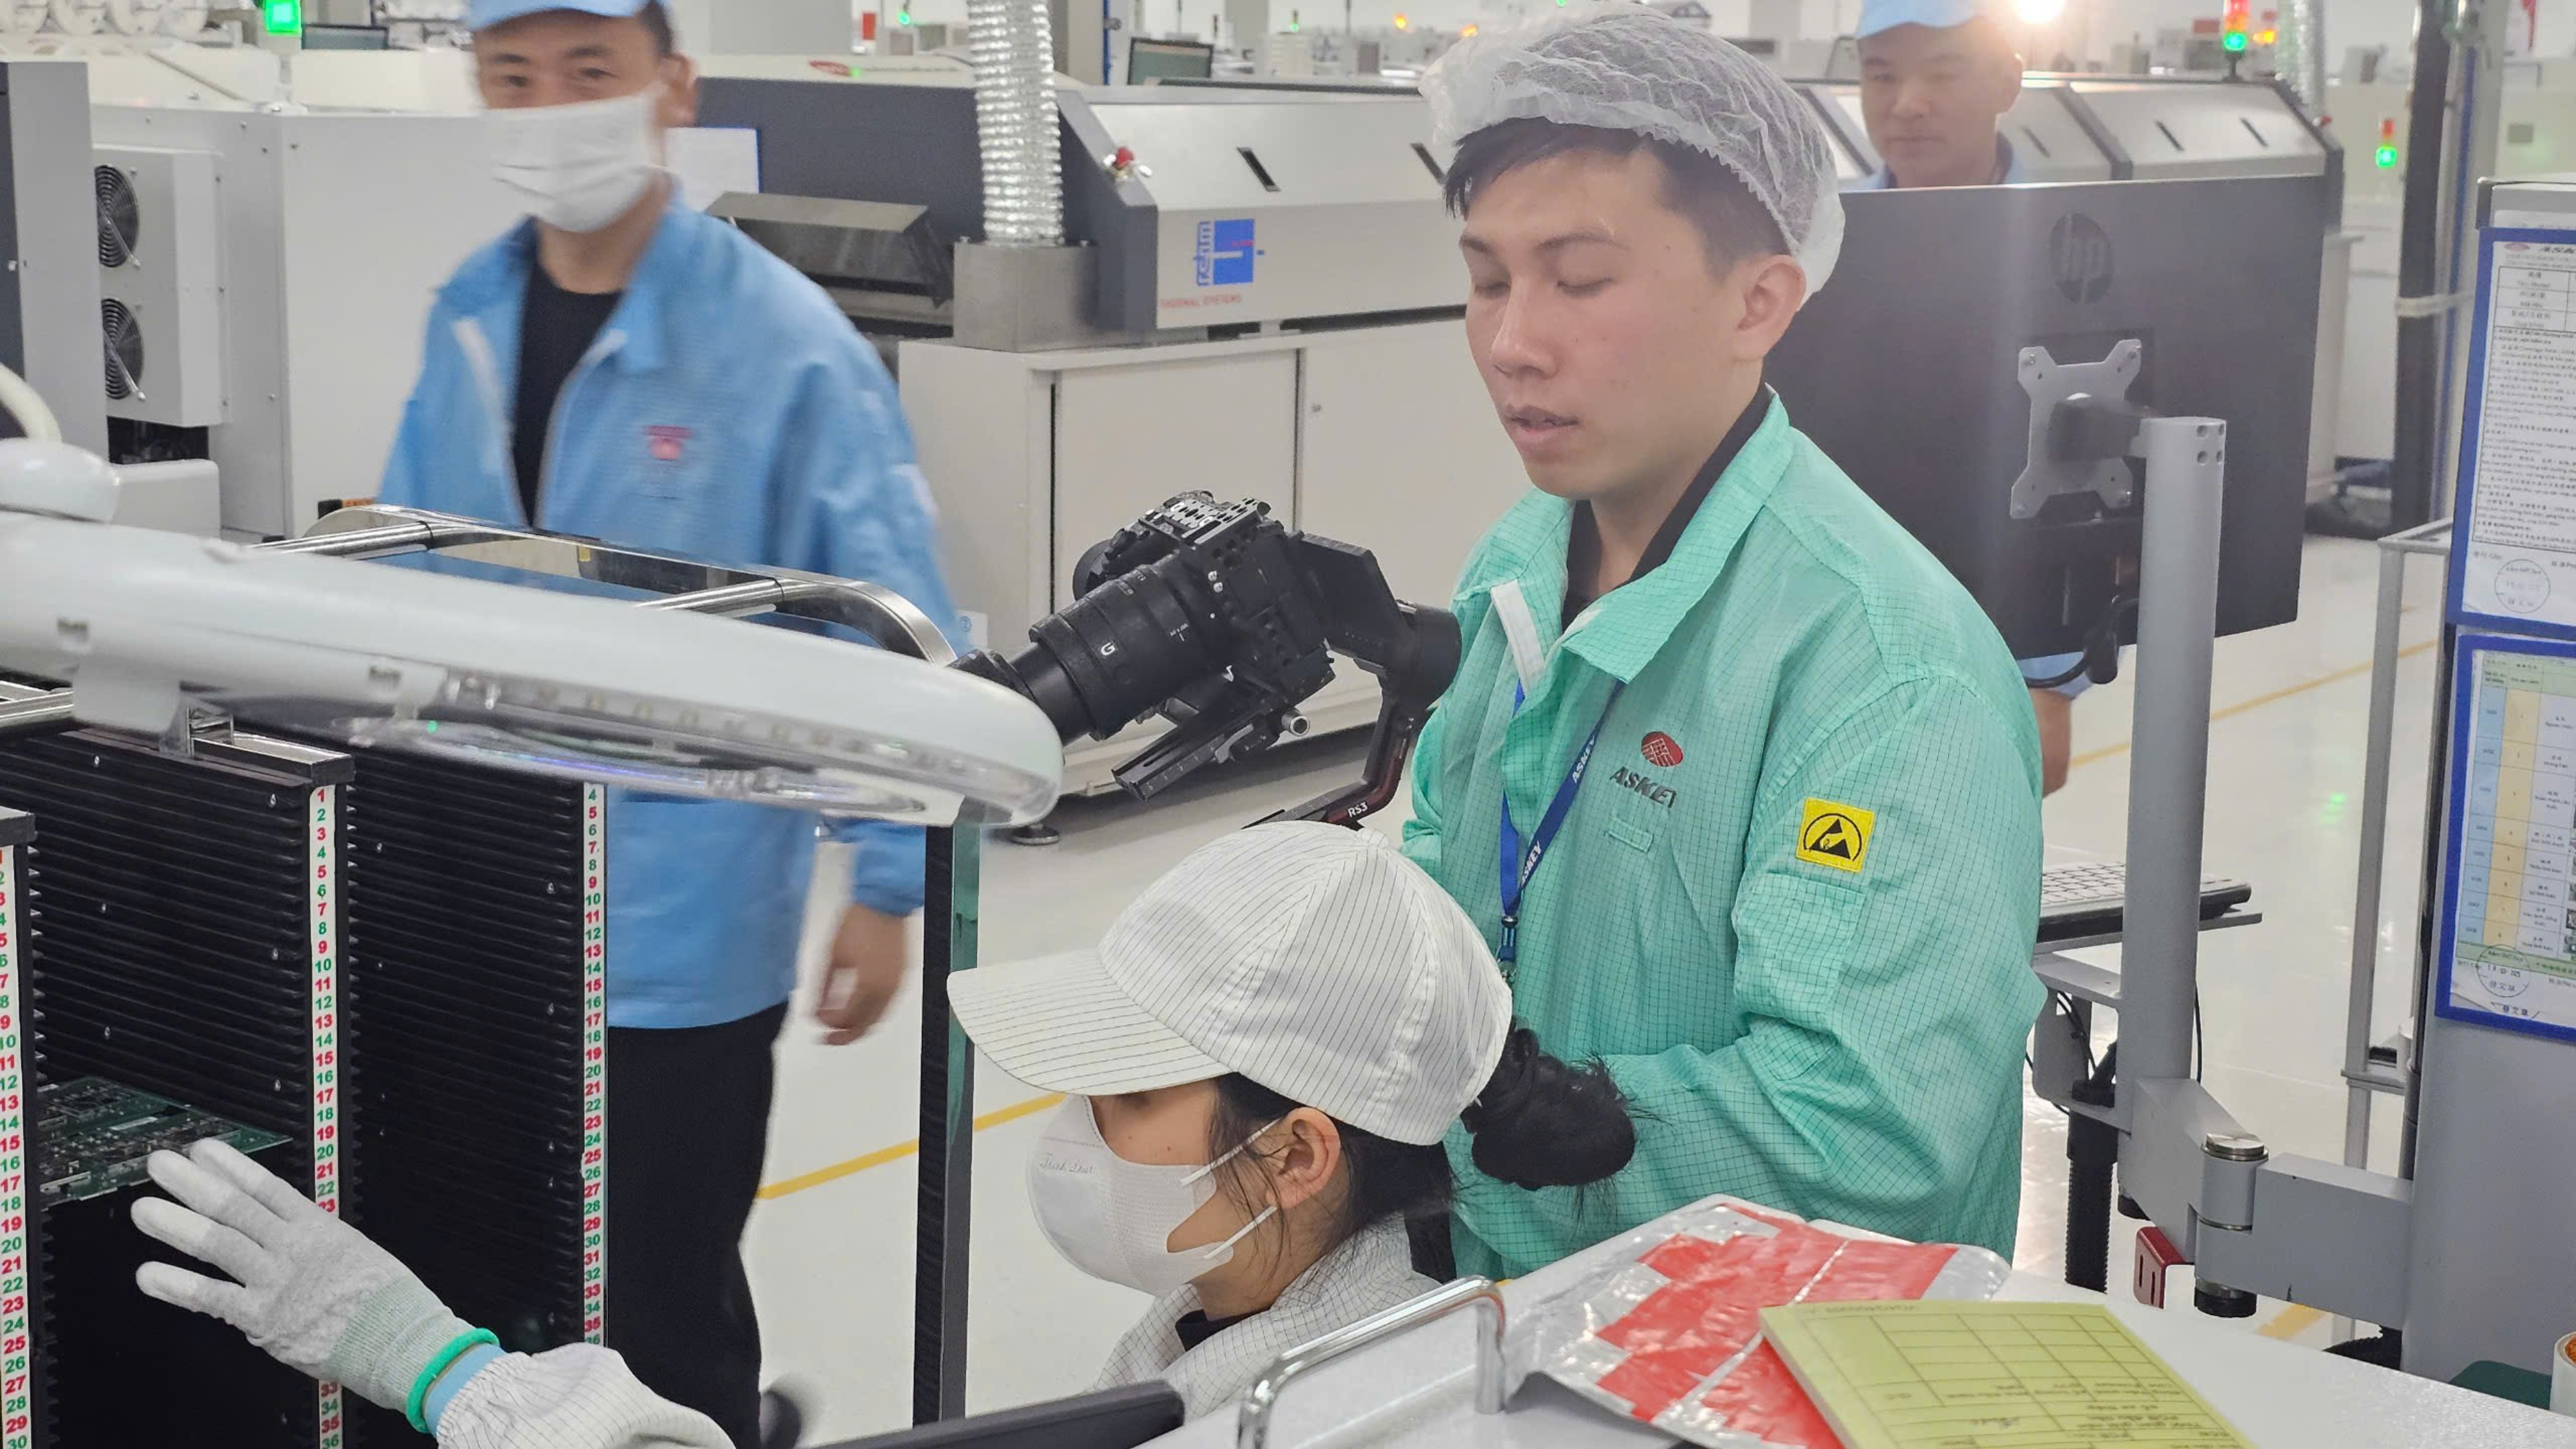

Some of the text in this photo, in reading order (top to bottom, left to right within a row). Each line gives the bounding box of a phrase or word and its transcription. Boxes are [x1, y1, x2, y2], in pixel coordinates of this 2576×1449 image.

[1100, 642, 1116, 655] G
[317, 789, 325, 802] 1
[588, 789, 596, 800] 4
[317, 809, 326, 821] 2
[589, 807, 597, 818] 5
[1348, 802, 1368, 818] RS3
[317, 827, 326, 840] 3
[589, 824, 596, 835] 6
[317, 846, 326, 859] 4
[588, 841, 596, 853] 7
[317, 864, 326, 878] 5
[589, 860, 596, 870] 8
[589, 876, 597, 888] 9
[317, 884, 326, 897] 6
[586, 893, 601, 906] 10
[318, 902, 327, 916] 7
[586, 910, 599, 924] 11
[319, 921, 327, 934] 8
[586, 928, 601, 941] 12
[0, 932, 8, 947] 5
[318, 941, 328, 954] 9
[586, 945, 601, 958] 13
[315, 958, 332, 973] 10
[586, 963, 601, 975] 14
[0, 974, 8, 989] 7
[315, 976, 330, 992] 11
[586, 978, 602, 993] 15
[0, 995, 9, 1008] 8
[315, 996, 332, 1010] 12
[586, 996, 601, 1010] 16
[0, 1015, 11, 1030] 9
[315, 1014, 332, 1029] 13
[586, 1013, 602, 1028] 17
[0, 1035, 16, 1050] 10
[316, 1033, 332, 1047] 14
[586, 1031, 601, 1044] 18
[316, 1051, 333, 1066] 15
[585, 1046, 602, 1061] 19
[0, 1055, 15, 1071] 11
[316, 1070, 333, 1085] 16
[585, 1064, 601, 1079] 20
[0, 1075, 17, 1090] 12
[585, 1081, 600, 1096] 21
[0, 1094, 19, 1112] 13
[317, 1088, 333, 1104] 17
[585, 1099, 601, 1112] 22
[317, 1107, 333, 1122] 18
[585, 1114, 602, 1130] 23
[0, 1115, 19, 1132] 14
[317, 1125, 335, 1141] 19
[585, 1132, 601, 1147] 24
[0, 1135, 21, 1152] 15
[317, 1144, 334, 1160] 20
[585, 1148, 601, 1165] 25
[1, 1156, 20, 1172] 16
[317, 1162, 333, 1180] 21
[585, 1167, 600, 1180] 26
[1, 1175, 21, 1192] 17
[317, 1181, 335, 1198] 22
[585, 1182, 600, 1198] 27
[1, 1196, 21, 1212] 18
[585, 1200, 600, 1215] 28
[1, 1216, 23, 1233] 19
[584, 1216, 601, 1232] 29
[1, 1236, 22, 1254] 20
[585, 1234, 600, 1248] 30
[2, 1256, 21, 1274] 21
[585, 1250, 599, 1266] 31
[585, 1268, 600, 1282] 32
[3, 1277, 23, 1294] 22
[585, 1283, 600, 1299] 33
[3, 1296, 24, 1314] 23
[585, 1301, 600, 1315] 34
[4, 1316, 24, 1334] 24
[584, 1316, 600, 1332] 35
[4, 1335, 26, 1354] 25
[5, 1356, 25, 1374] 26
[5, 1375, 26, 1395] 27
[6, 1396, 26, 1414] 28
[321, 1398, 339, 1415] 34
[6, 1415, 27, 1434] 29
[8, 1435, 27, 1449] 30
